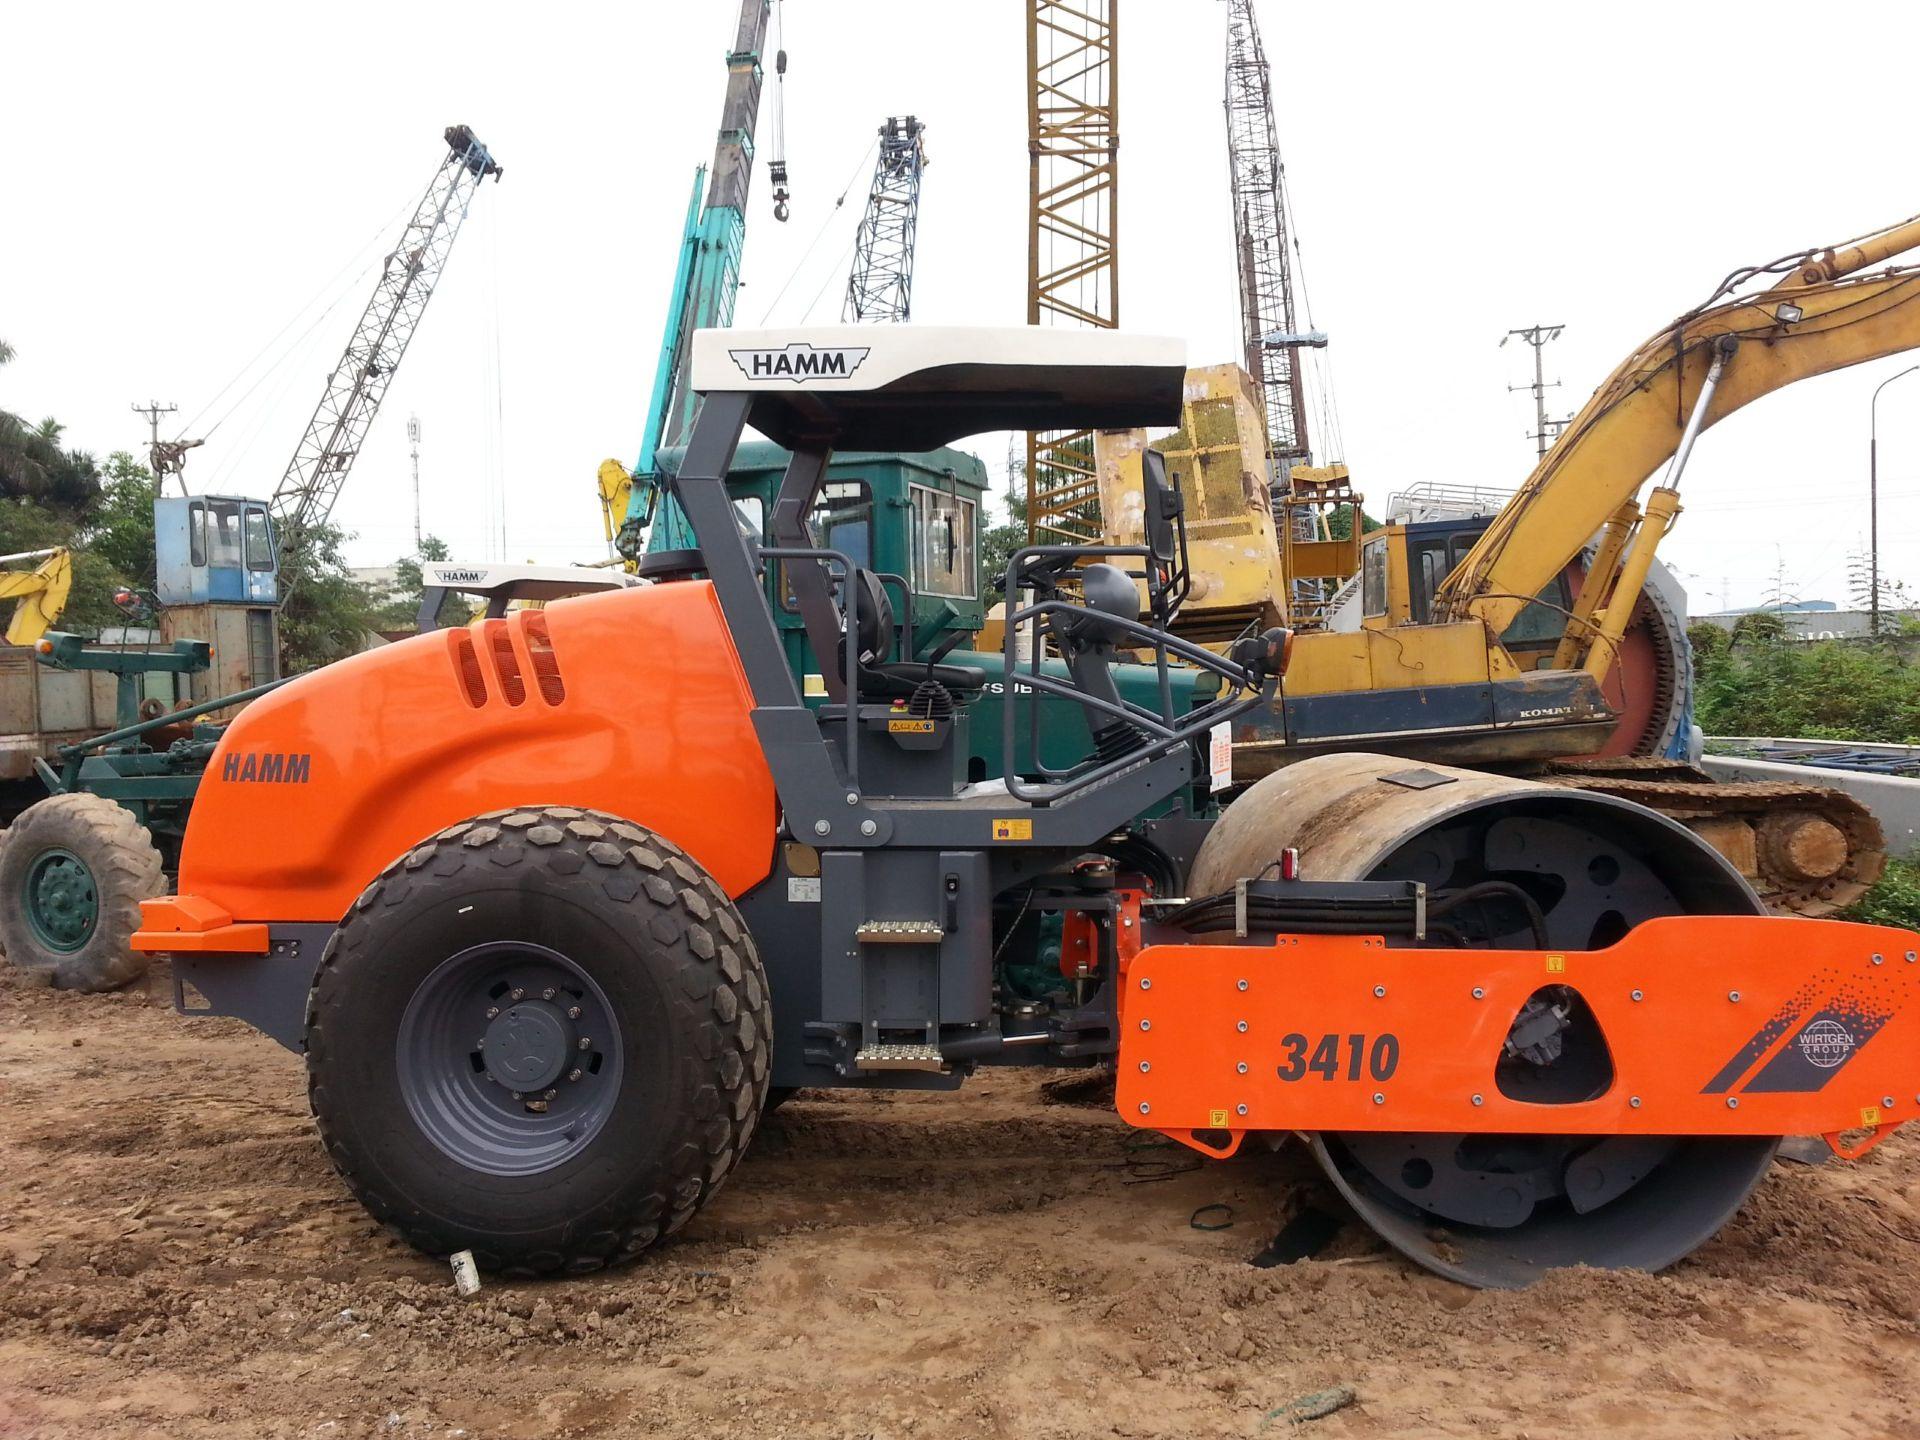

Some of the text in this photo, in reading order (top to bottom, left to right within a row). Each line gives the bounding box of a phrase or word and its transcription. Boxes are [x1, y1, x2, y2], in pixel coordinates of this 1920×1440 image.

[753, 352, 846, 375] HAMM
[443, 572, 479, 581] HAMM
[222, 752, 311, 783] HAMM
[1800, 1033, 1854, 1043] WIRTGEN
[1277, 1033, 1400, 1081] 3410
[1803, 1045, 1849, 1053] GROUP
